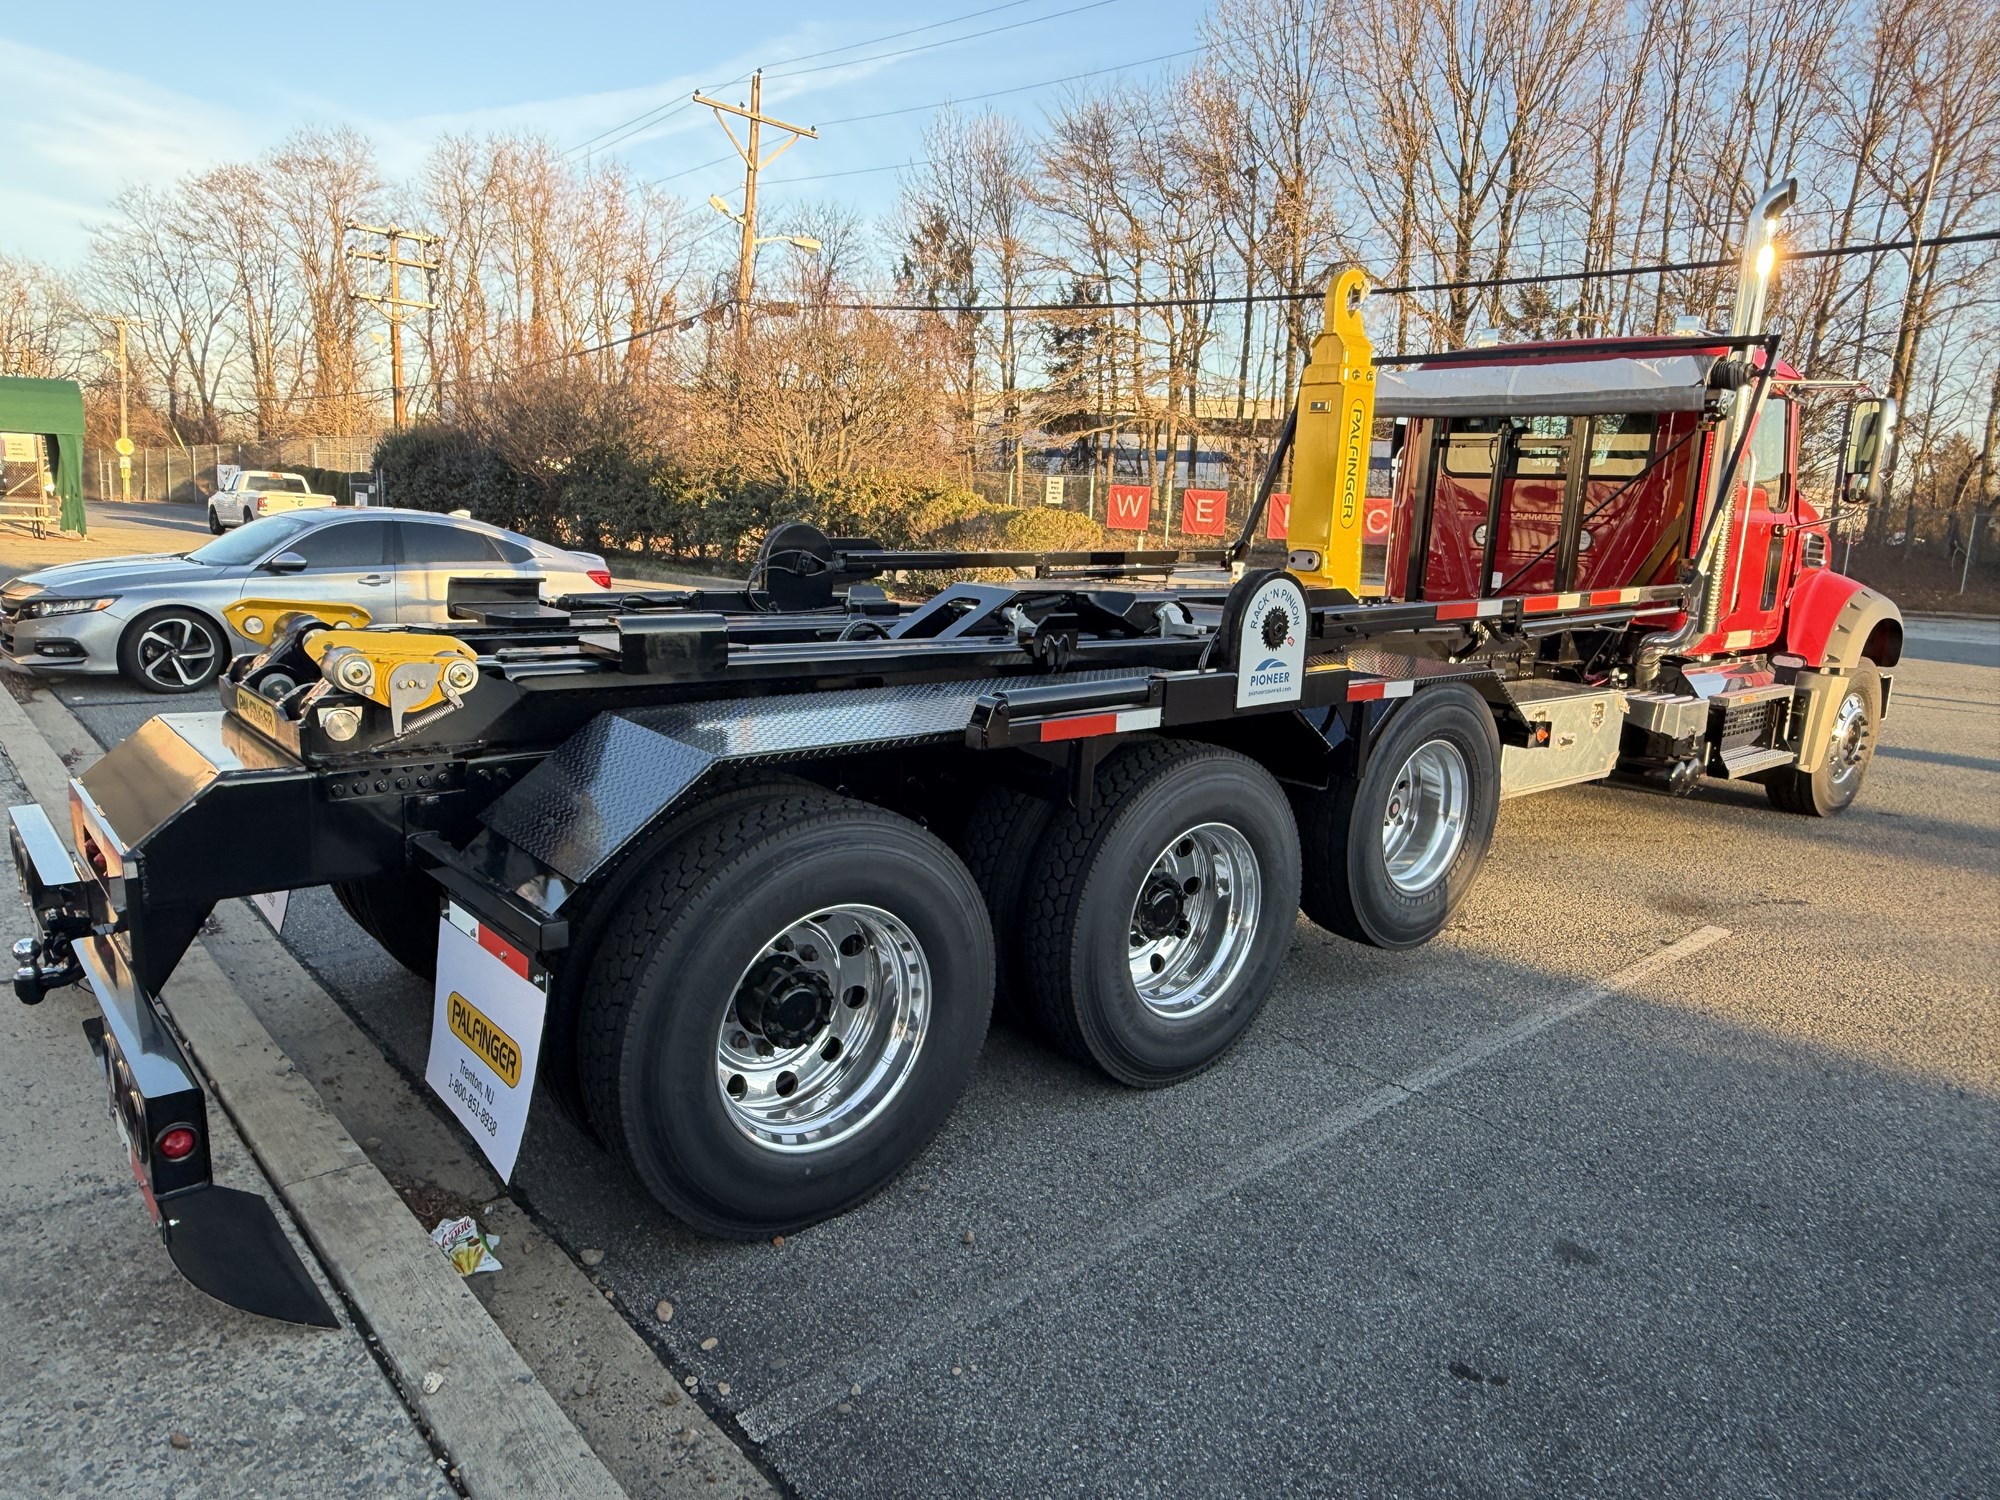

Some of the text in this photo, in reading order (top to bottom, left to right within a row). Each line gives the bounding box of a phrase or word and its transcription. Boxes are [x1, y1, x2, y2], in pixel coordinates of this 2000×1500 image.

[1343, 409, 1362, 519] PALFINGER
[1116, 494, 1143, 518] W
[1196, 499, 1214, 523] E
[1366, 509, 1388, 534] C
[1250, 593, 1269, 629] RACK
[1280, 589, 1300, 626] PINION
[1250, 672, 1290, 687] PIONEER
[452, 998, 517, 1079] PALFINGER
[460, 1058, 495, 1106] Trenton, NJ
[448, 1073, 498, 1137] 1-800-851-8938
